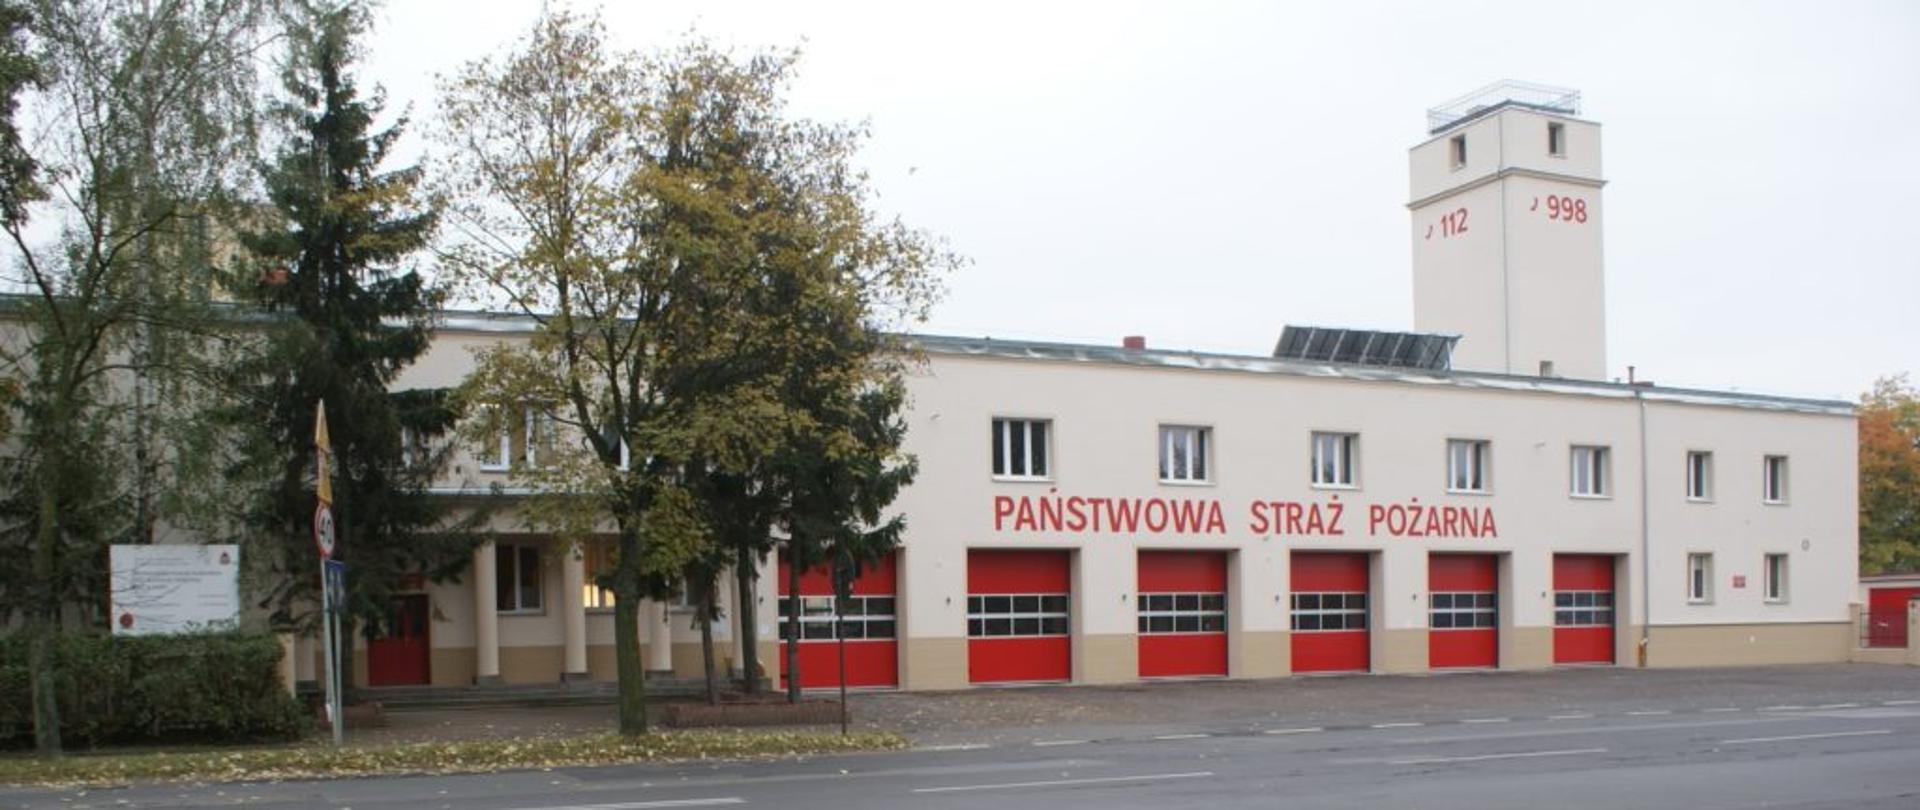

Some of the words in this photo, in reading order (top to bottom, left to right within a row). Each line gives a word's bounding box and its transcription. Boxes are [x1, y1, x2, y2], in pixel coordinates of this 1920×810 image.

[1440, 208, 1468, 238] 112
[1547, 194, 1587, 224] 998
[993, 488, 1226, 535] PAŃSTWOWA
[1250, 495, 1344, 536] STRAŻ
[1369, 498, 1497, 538] POŻARNA
